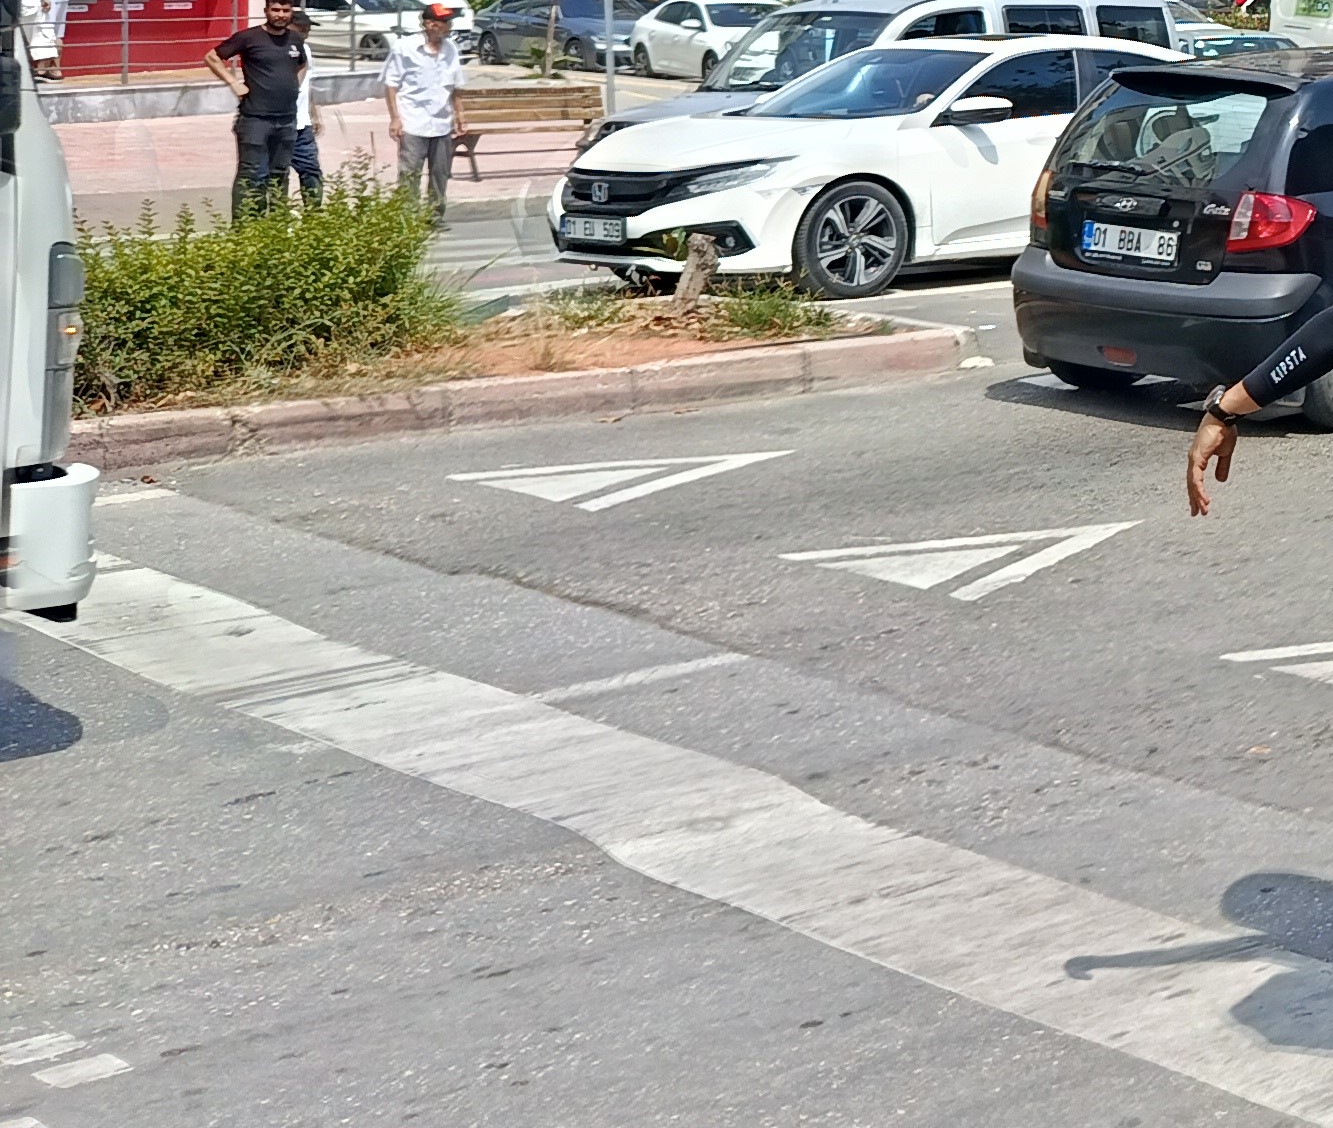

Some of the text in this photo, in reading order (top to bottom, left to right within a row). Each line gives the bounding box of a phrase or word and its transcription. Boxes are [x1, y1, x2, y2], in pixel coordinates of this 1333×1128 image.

[566, 219, 576, 235] 01
[1093, 227, 1174, 257] 01 BBA 86
[1270, 346, 1308, 384] KIPSTA
